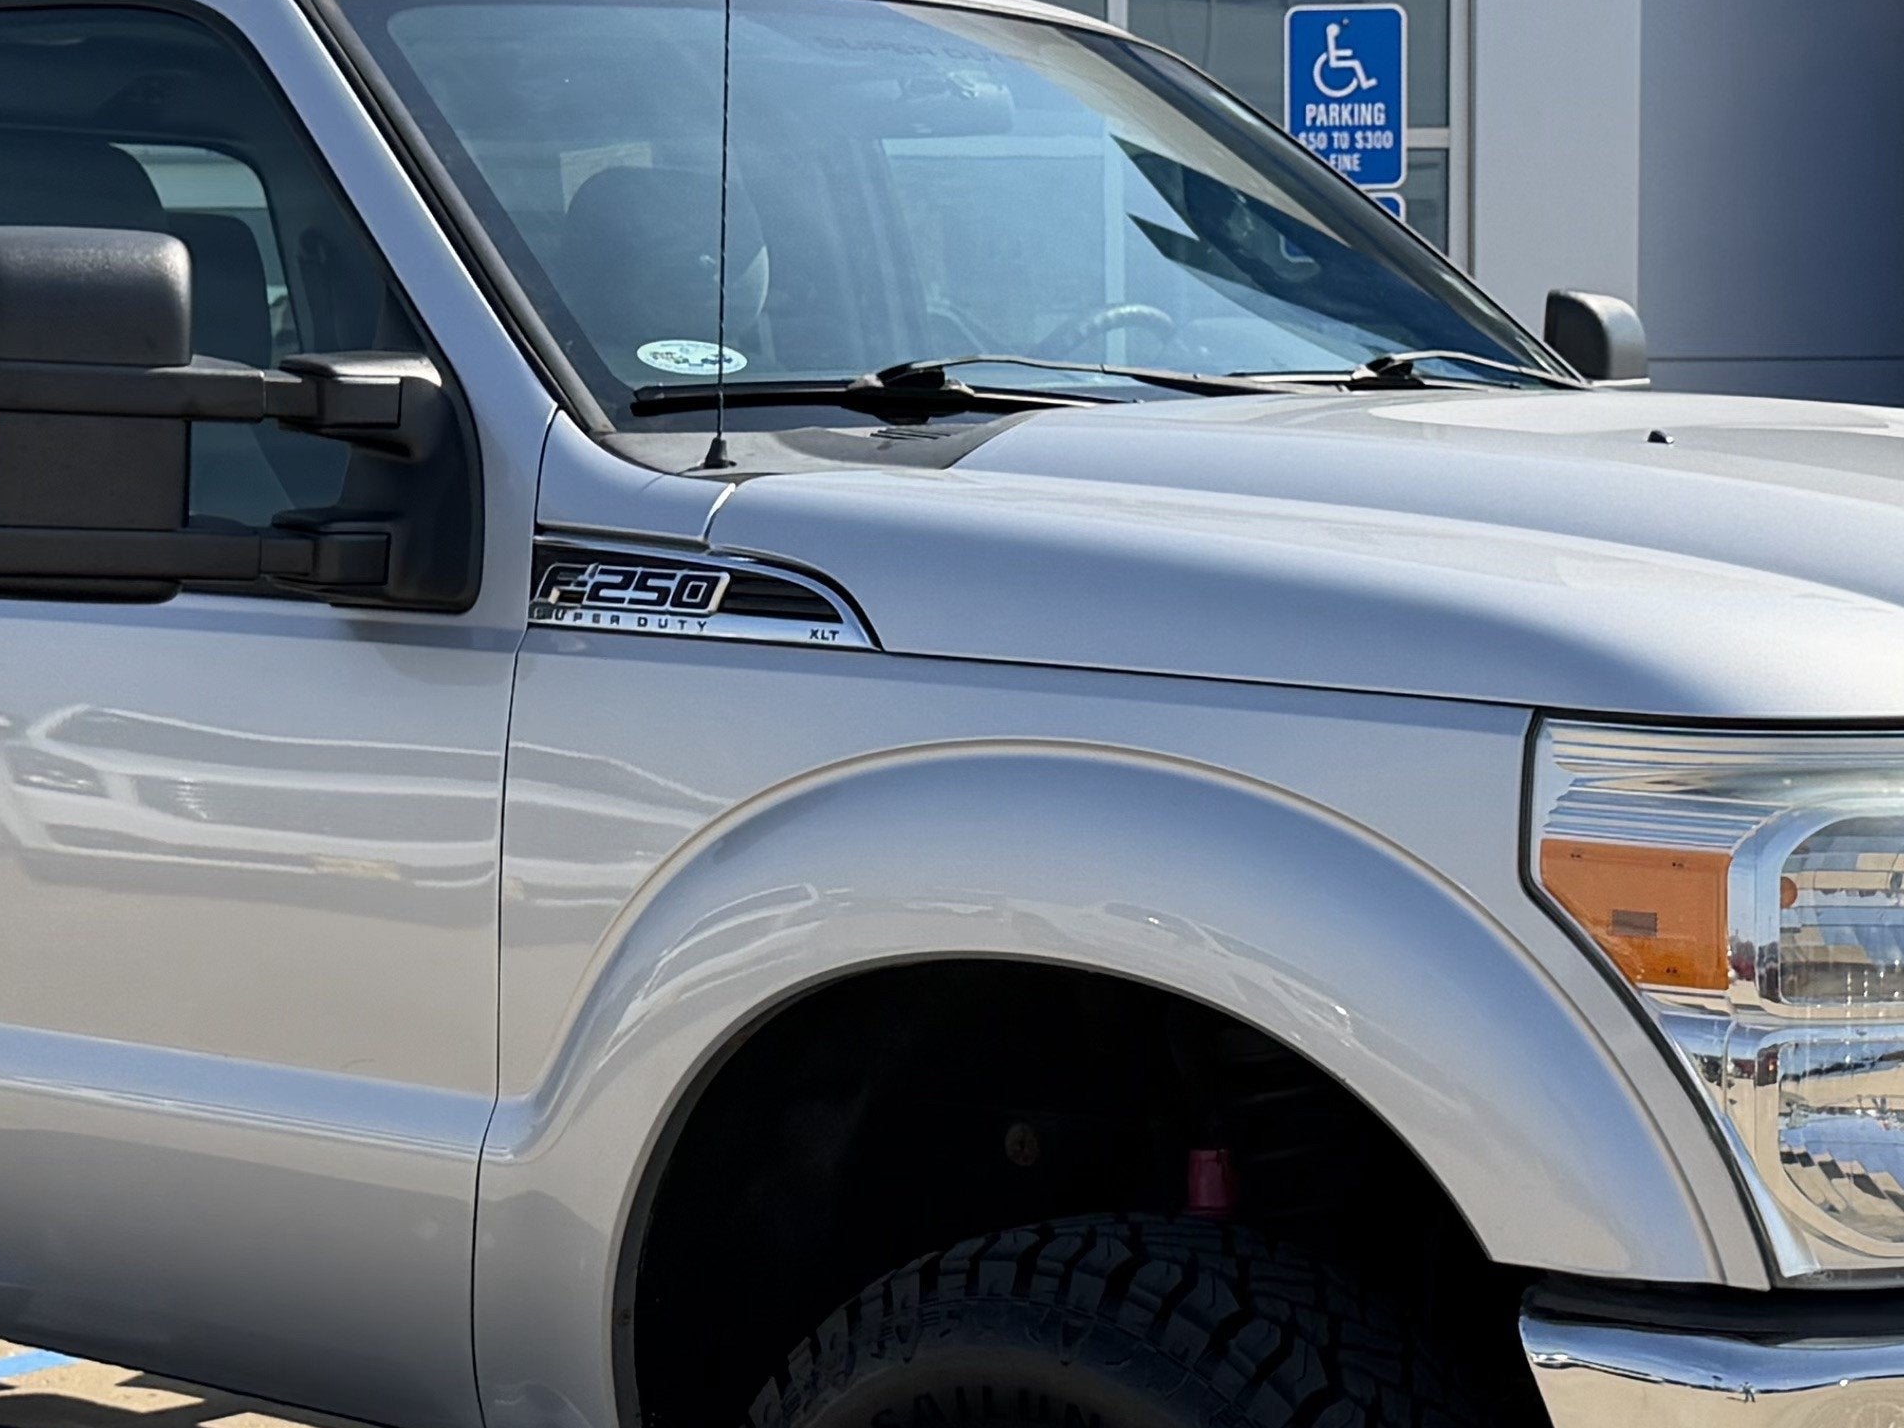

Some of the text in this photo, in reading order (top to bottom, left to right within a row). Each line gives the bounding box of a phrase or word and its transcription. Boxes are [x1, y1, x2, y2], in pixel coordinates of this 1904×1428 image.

[1304, 102, 1386, 126] PARKING
[1331, 131, 1351, 149] TO
[1354, 130, 1394, 150] $300
[530, 561, 732, 616] F-250
[533, 604, 708, 632] SUPER DUTY
[809, 628, 840, 642] XLT
